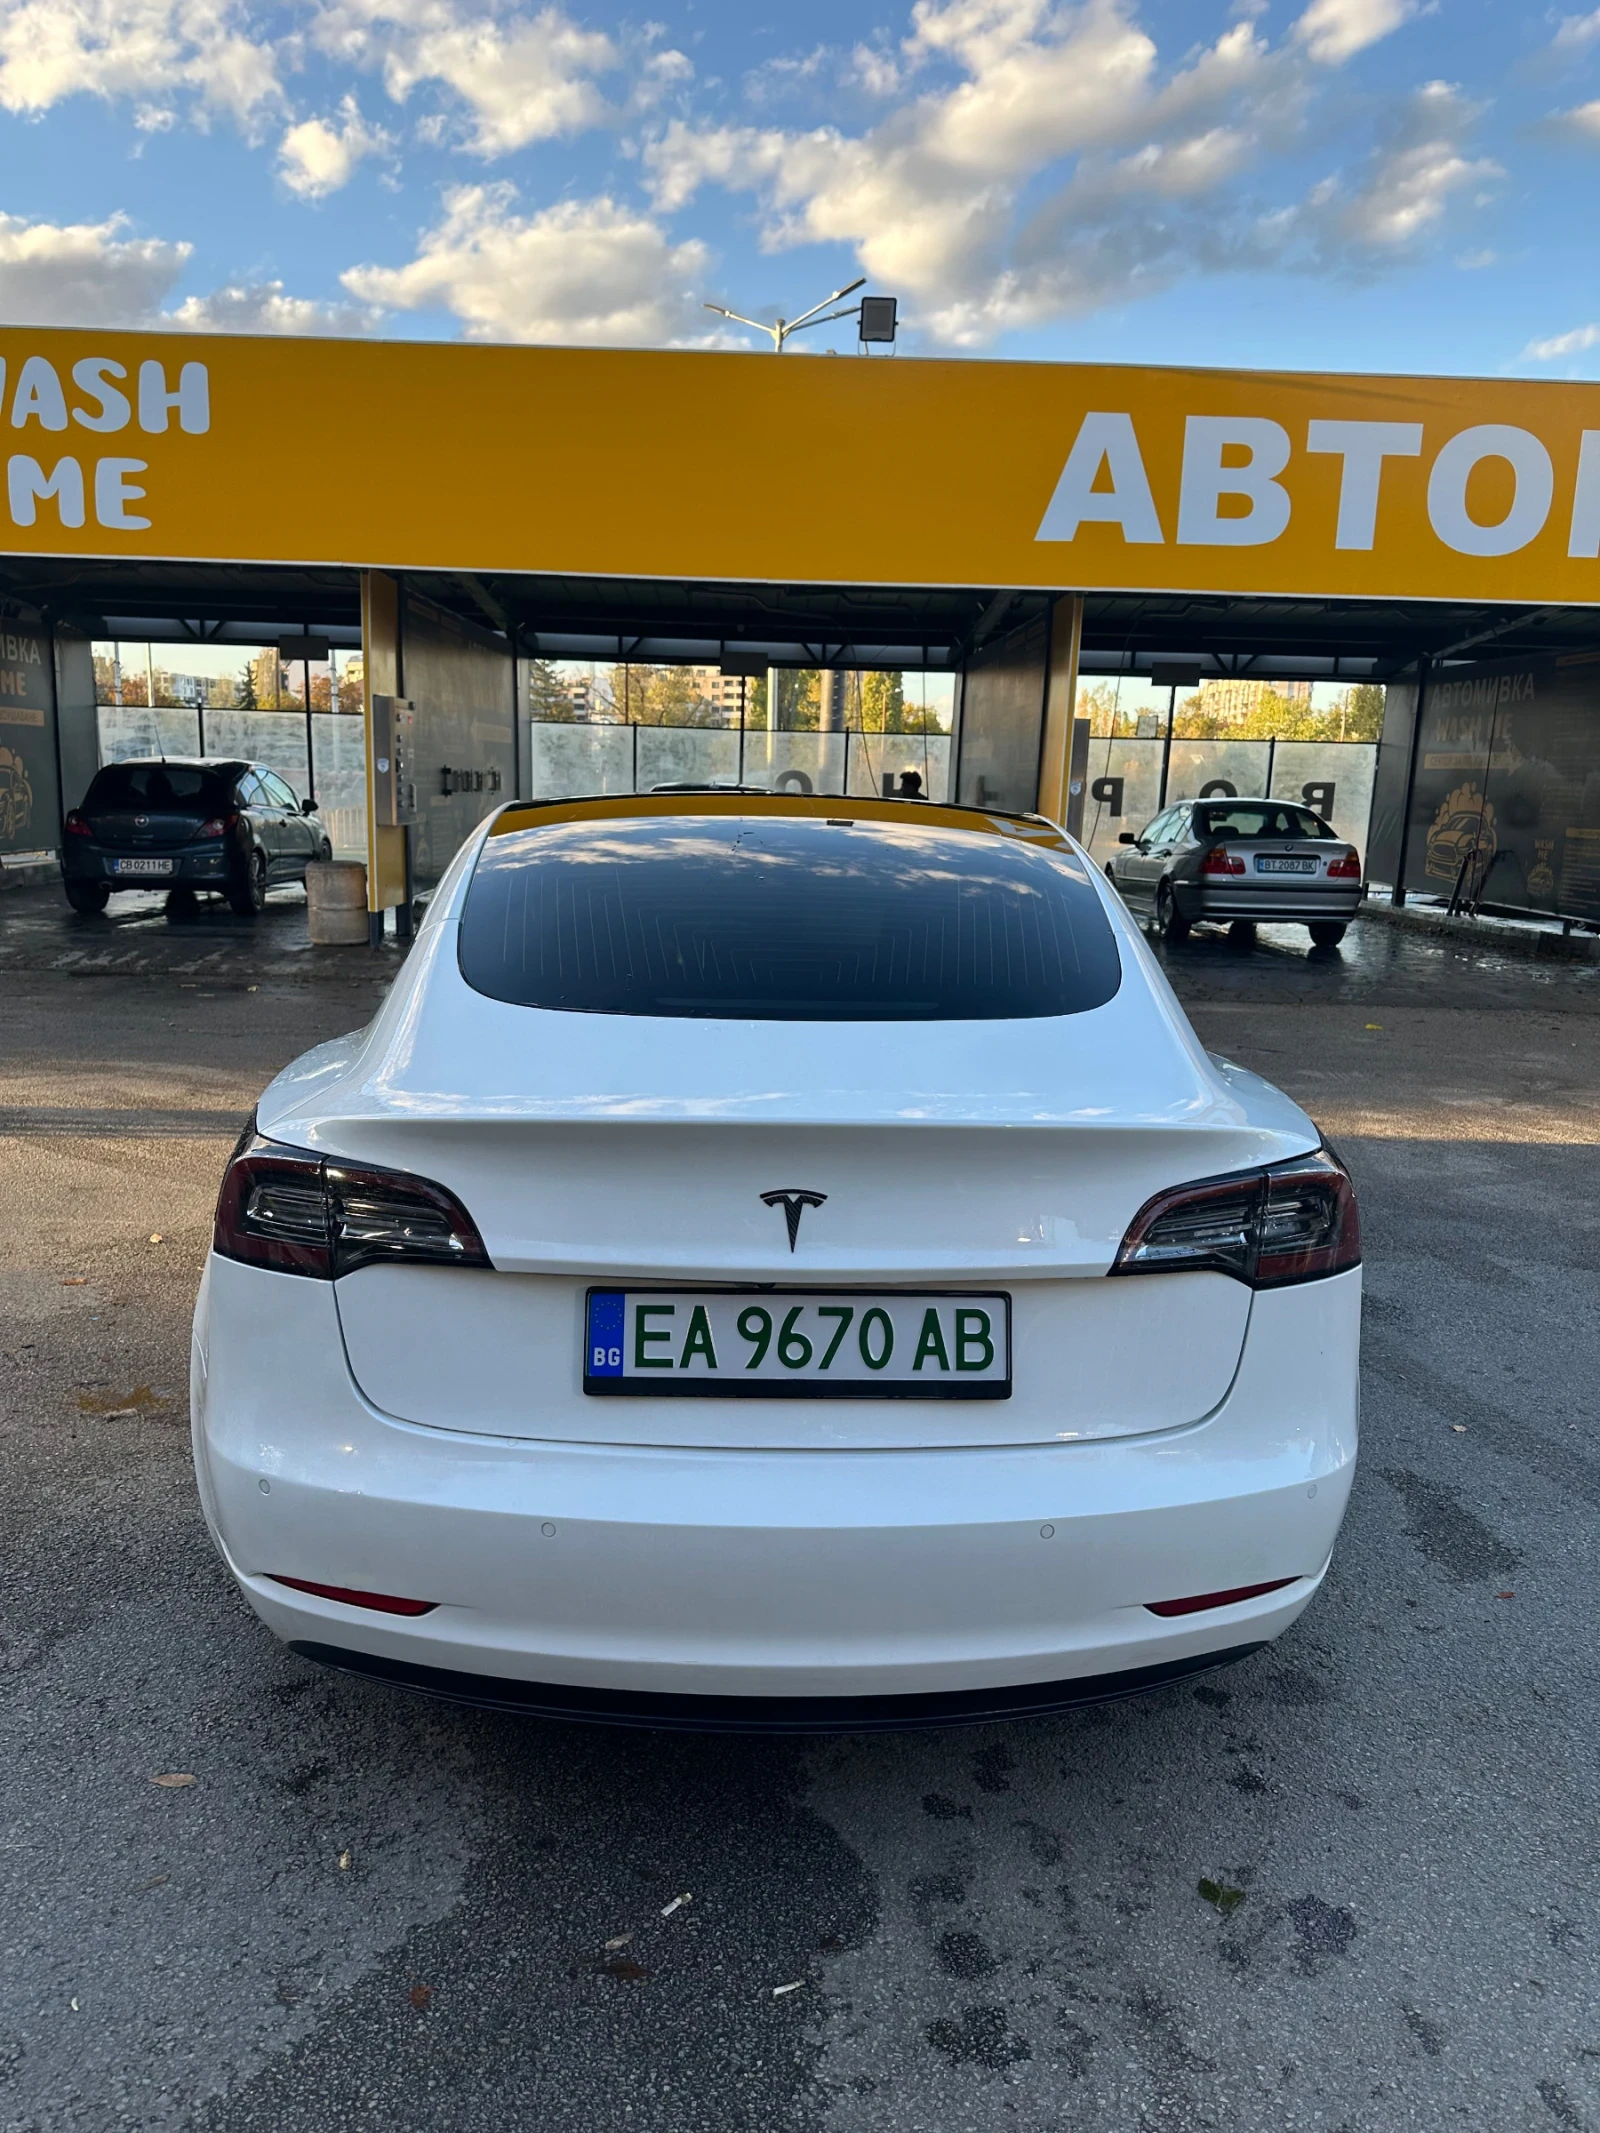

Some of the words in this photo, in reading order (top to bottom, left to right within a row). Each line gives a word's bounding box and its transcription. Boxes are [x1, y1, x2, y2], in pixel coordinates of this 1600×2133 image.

[0, 356, 210, 434] ASH
[8, 454, 152, 530] ME
[1, 671, 27, 696] ME
[1430, 672, 1535, 709] АВТОМИВКА
[1436, 715, 1482, 742] WASH
[120, 860, 133, 870] CB
[134, 860, 156, 870] 0211
[158, 861, 170, 870] HE
[1264, 860, 1276, 869] BT
[1278, 860, 1300, 871] 2087
[1302, 861, 1314, 871] BK
[634, 1305, 718, 1369] EA
[736, 1306, 894, 1370] 9670
[912, 1308, 995, 1371] AB
[593, 1347, 620, 1367] BG
